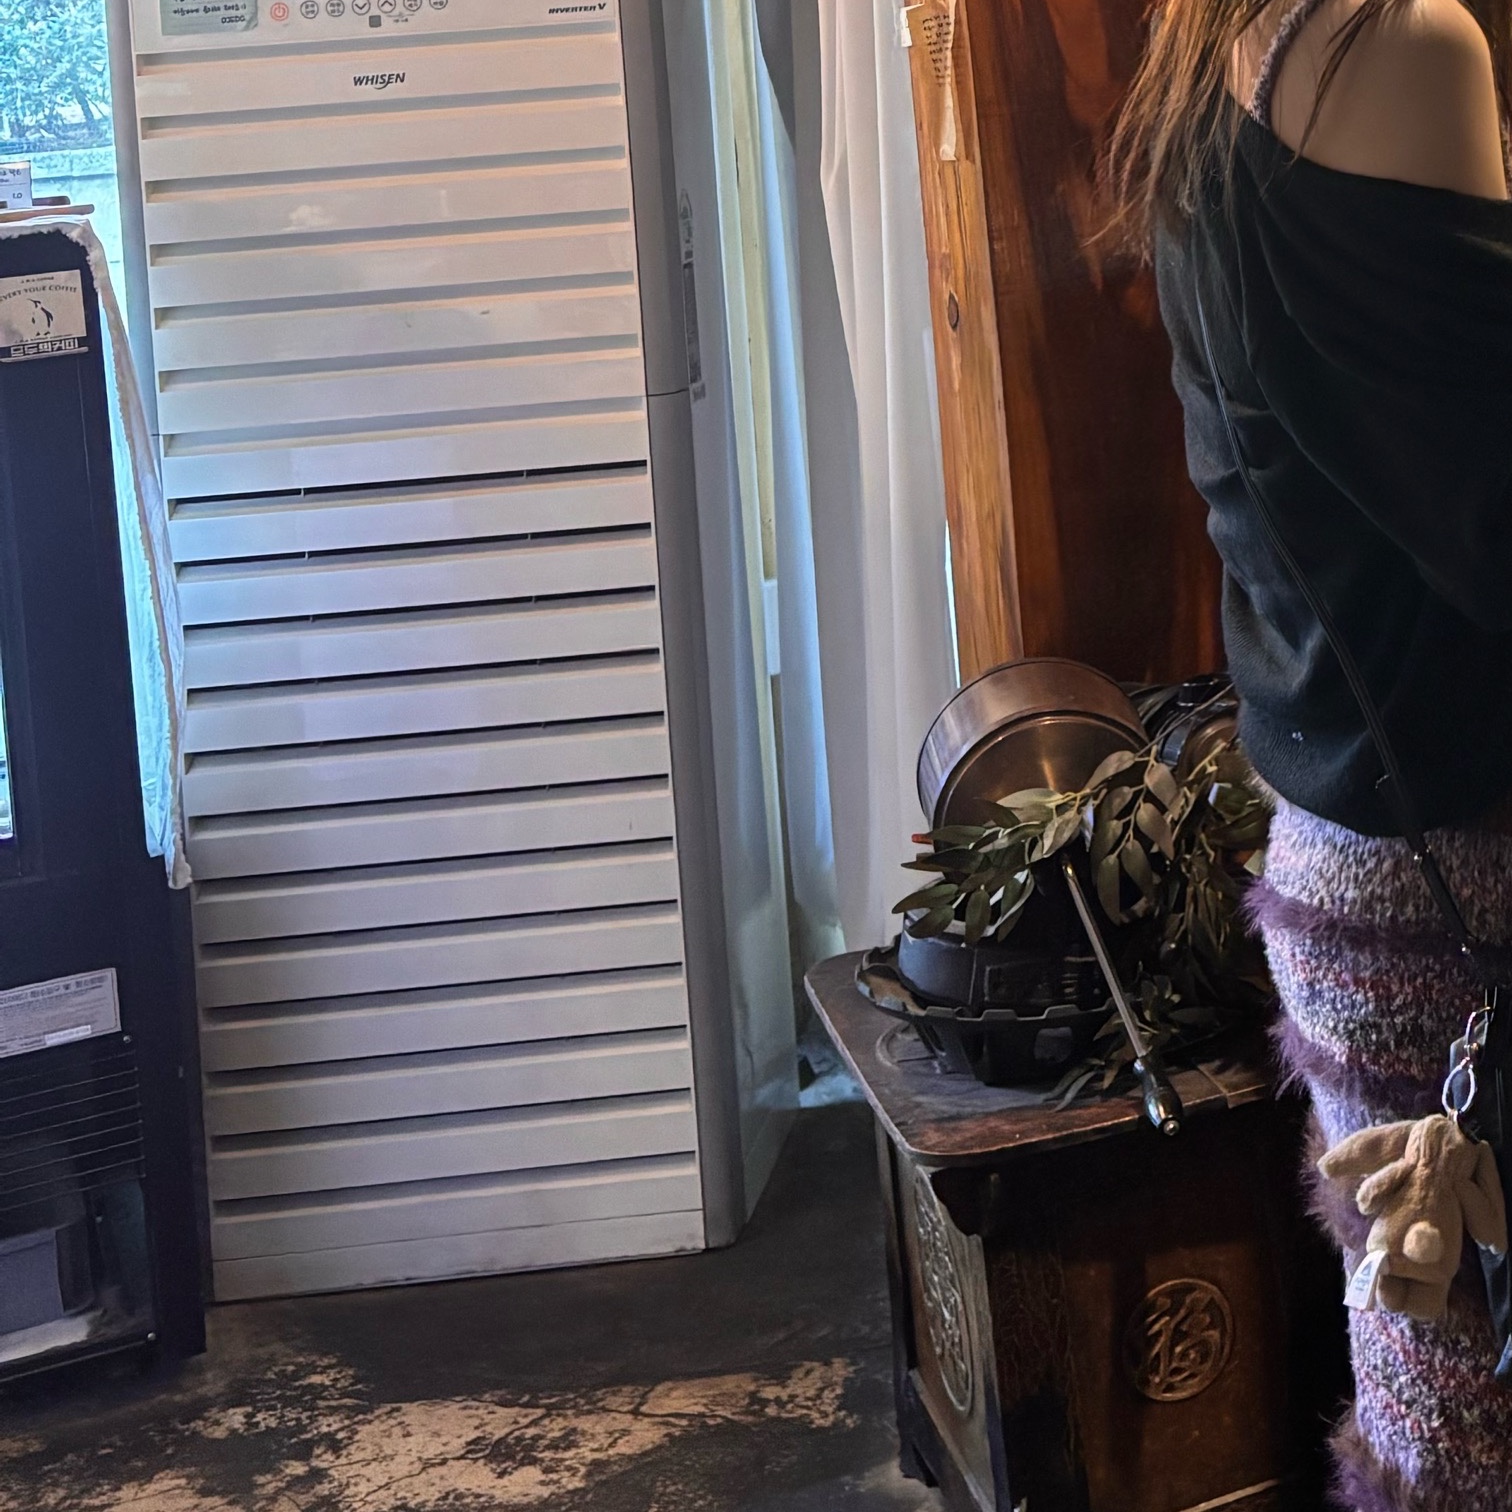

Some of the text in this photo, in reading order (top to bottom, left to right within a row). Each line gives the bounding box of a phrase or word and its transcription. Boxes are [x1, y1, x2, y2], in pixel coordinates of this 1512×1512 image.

[548, 2, 607, 14] INVERTER V
[352, 72, 406, 89] WHISEN
